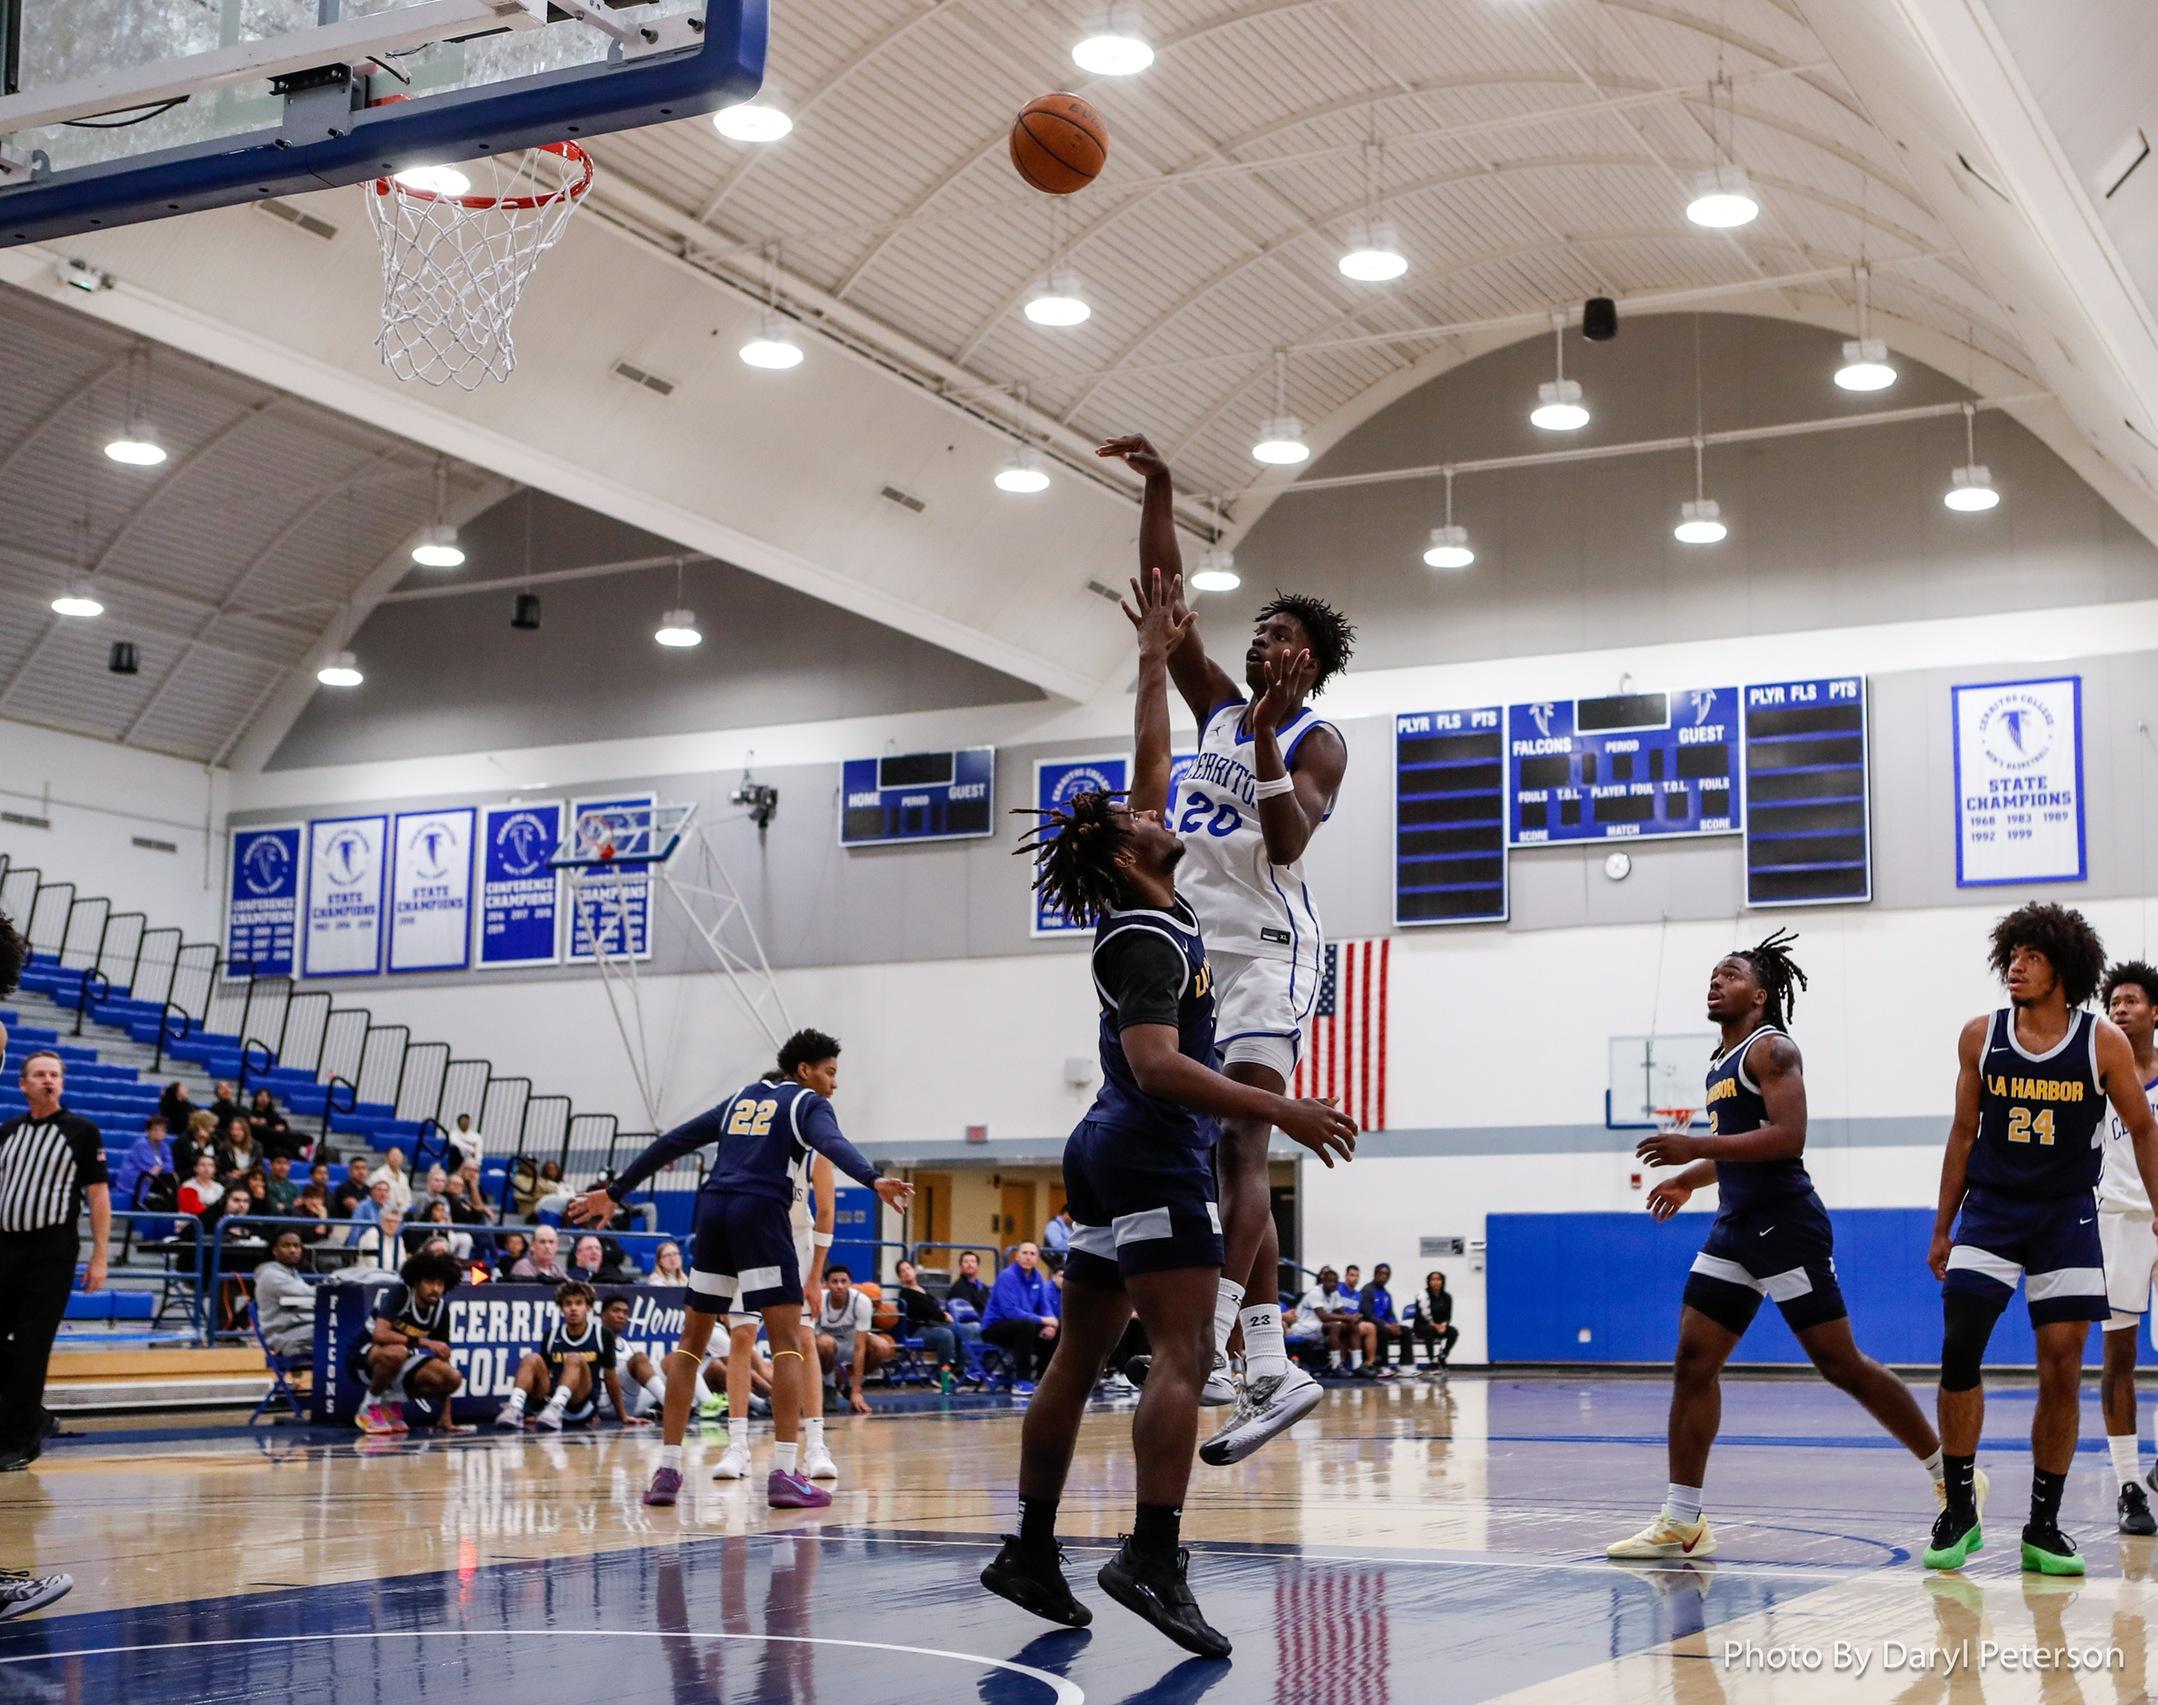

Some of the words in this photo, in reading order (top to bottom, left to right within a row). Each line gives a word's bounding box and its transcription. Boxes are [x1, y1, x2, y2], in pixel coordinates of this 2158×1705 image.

[1750, 686, 1785, 705] PLYR
[1790, 684, 1816, 702] FLS
[1829, 681, 1857, 699] PTS
[1398, 716, 1430, 734] PLYR
[1437, 713, 1461, 730] FLS
[1471, 711, 1497, 728] PTS
[1678, 725, 1725, 744] GUEST
[1512, 736, 1572, 757] FALCONS
[1605, 739, 1640, 754] PERIOD
[1184, 752, 1258, 808] CERRITO
[1989, 776, 2048, 793] STATE
[948, 783, 986, 800] GUEST
[1518, 790, 1548, 803] FOULS
[1556, 787, 1583, 801] T.O.L.
[1591, 785, 1626, 799] PLAYER
[1630, 782, 1654, 796] FOUL
[1663, 780, 1689, 793] T.O.L.
[1699, 777, 1730, 791] FOULS
[848, 792, 881, 808] HOME
[1966, 791, 2072, 811] CHAMPIONS
[1179, 791, 1242, 837] 20
[2007, 813, 2032, 825] 1983
[2044, 811, 2069, 823] 1989
[1606, 824, 1640, 836] MATCH
[1699, 817, 1730, 830] SCORE
[1519, 829, 1549, 842] SCORE
[1971, 831, 1996, 843] 1992
[2007, 829, 2032, 840] 1999
[413, 886, 448, 899] STATE
[485, 877, 554, 893] CONFERENCE
[327, 893, 362, 905] STATE
[397, 898, 463, 913] CHAMPIONS
[485, 891, 554, 909] CHAMPIONS
[313, 905, 375, 919] CHAMPIONS
[1987, 1074, 2007, 1097] LA
[2011, 1077, 2083, 1102] HARBOR
[727, 1098, 778, 1135] 22
[2008, 1106, 2055, 1145] 24
[1249, 1314, 1270, 1327] 23
[325, 1294, 338, 1414] FALCONS
